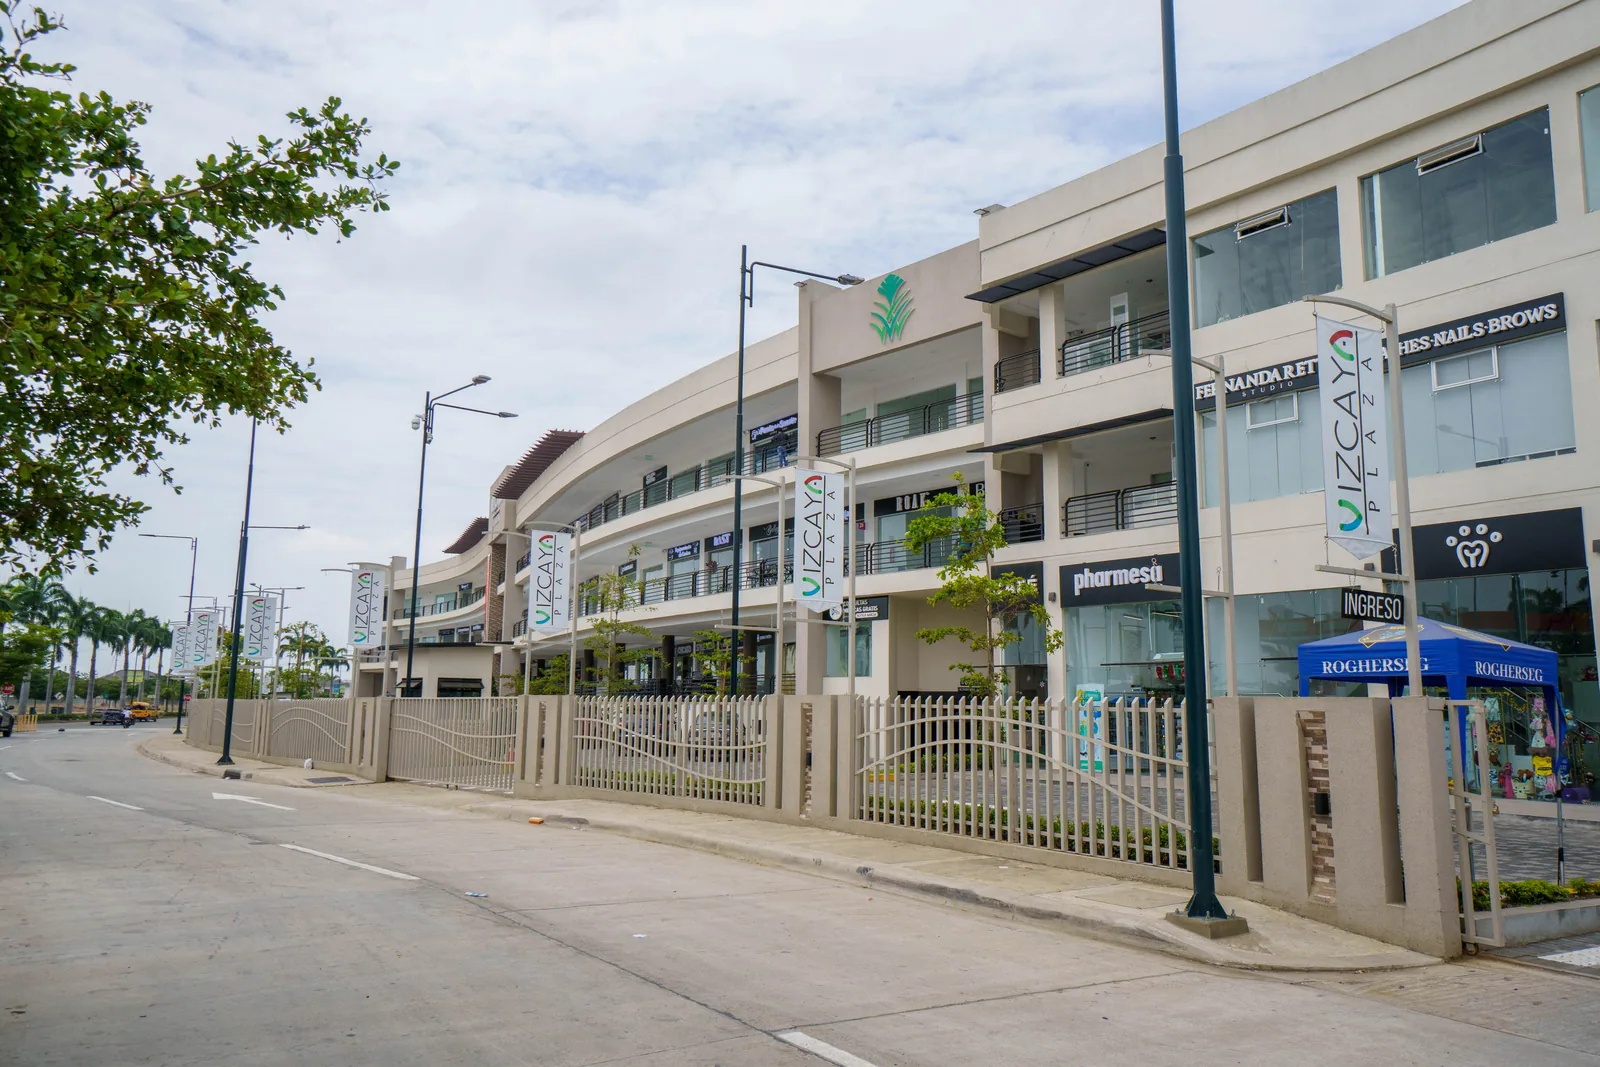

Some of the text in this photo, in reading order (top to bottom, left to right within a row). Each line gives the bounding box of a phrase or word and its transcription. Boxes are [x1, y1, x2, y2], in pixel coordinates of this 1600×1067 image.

[1242, 381, 1293, 397] STUDIO
[1329, 329, 1364, 532] VIZCAYA
[1361, 357, 1381, 513] PLAZA
[801, 475, 823, 597] VIZCAYA
[825, 490, 836, 585] PLAZA
[354, 572, 371, 643] VIZCAYA
[370, 580, 379, 636] PLAZA
[535, 534, 554, 625] VIZCAYA
[554, 545, 564, 616] PLAZA
[1074, 565, 1163, 596] pharmesa
[1344, 592, 1402, 621] INGRESO
[262, 605, 271, 650] PLAZA
[1475, 660, 1544, 682] ROGHERSEG
